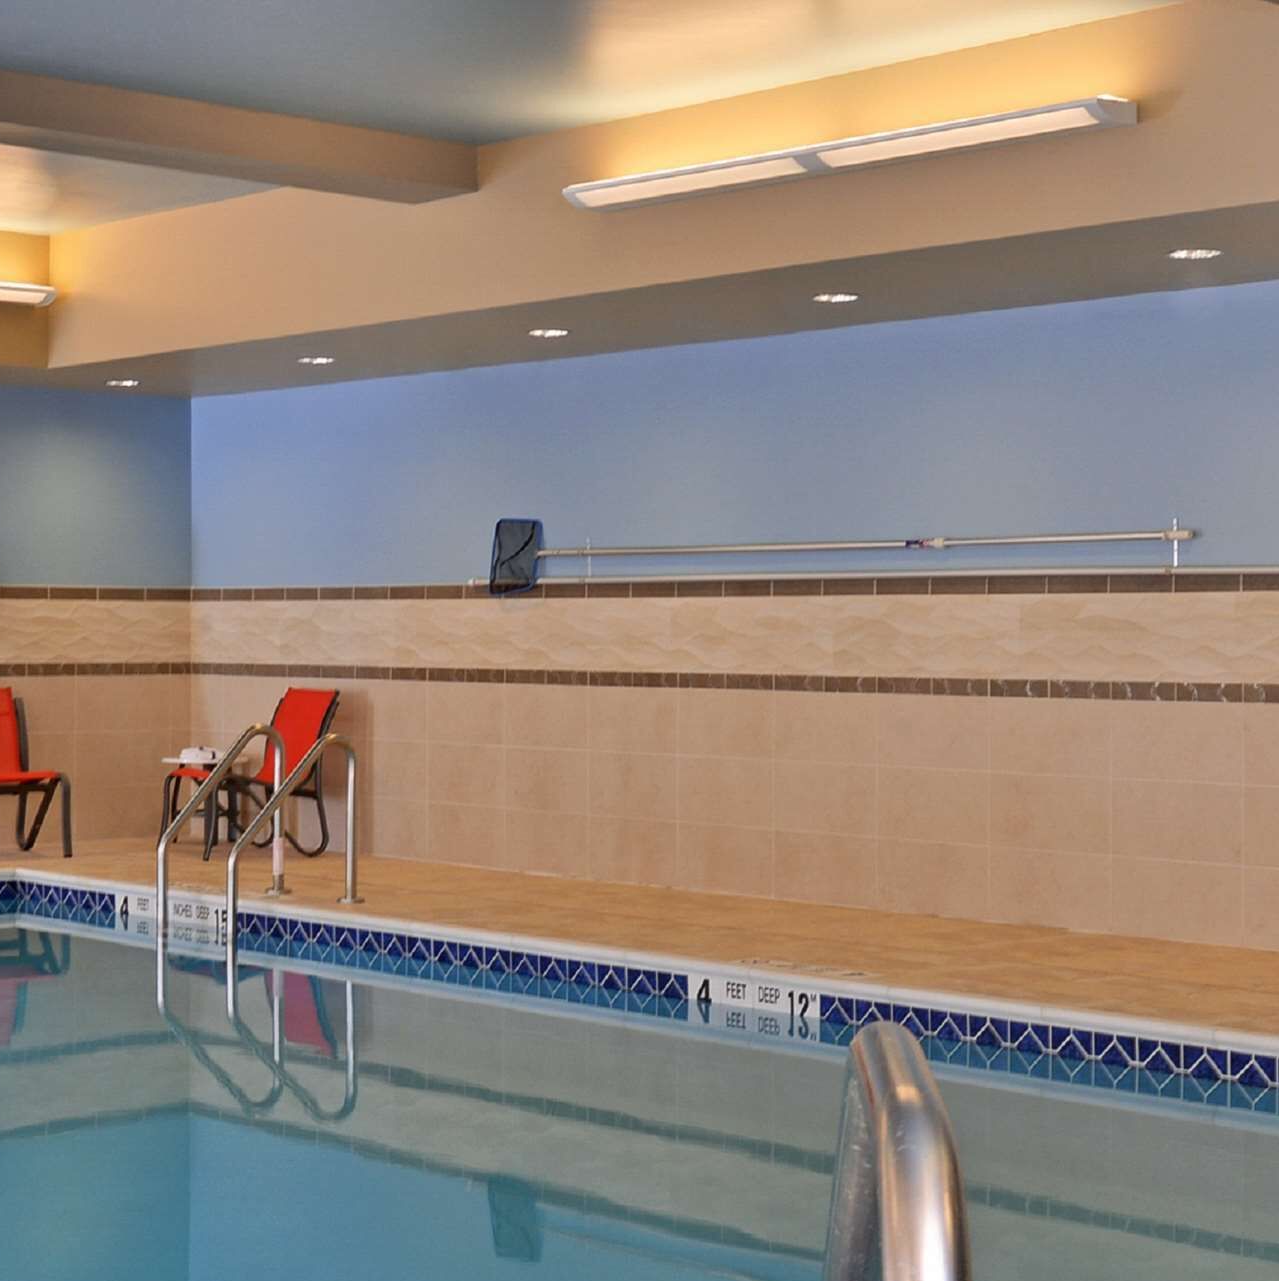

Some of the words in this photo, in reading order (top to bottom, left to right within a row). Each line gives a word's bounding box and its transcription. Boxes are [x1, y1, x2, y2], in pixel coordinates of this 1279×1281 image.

[696, 979, 712, 1002] 4
[726, 982, 747, 1000] FEET
[758, 986, 781, 1005] DEEP
